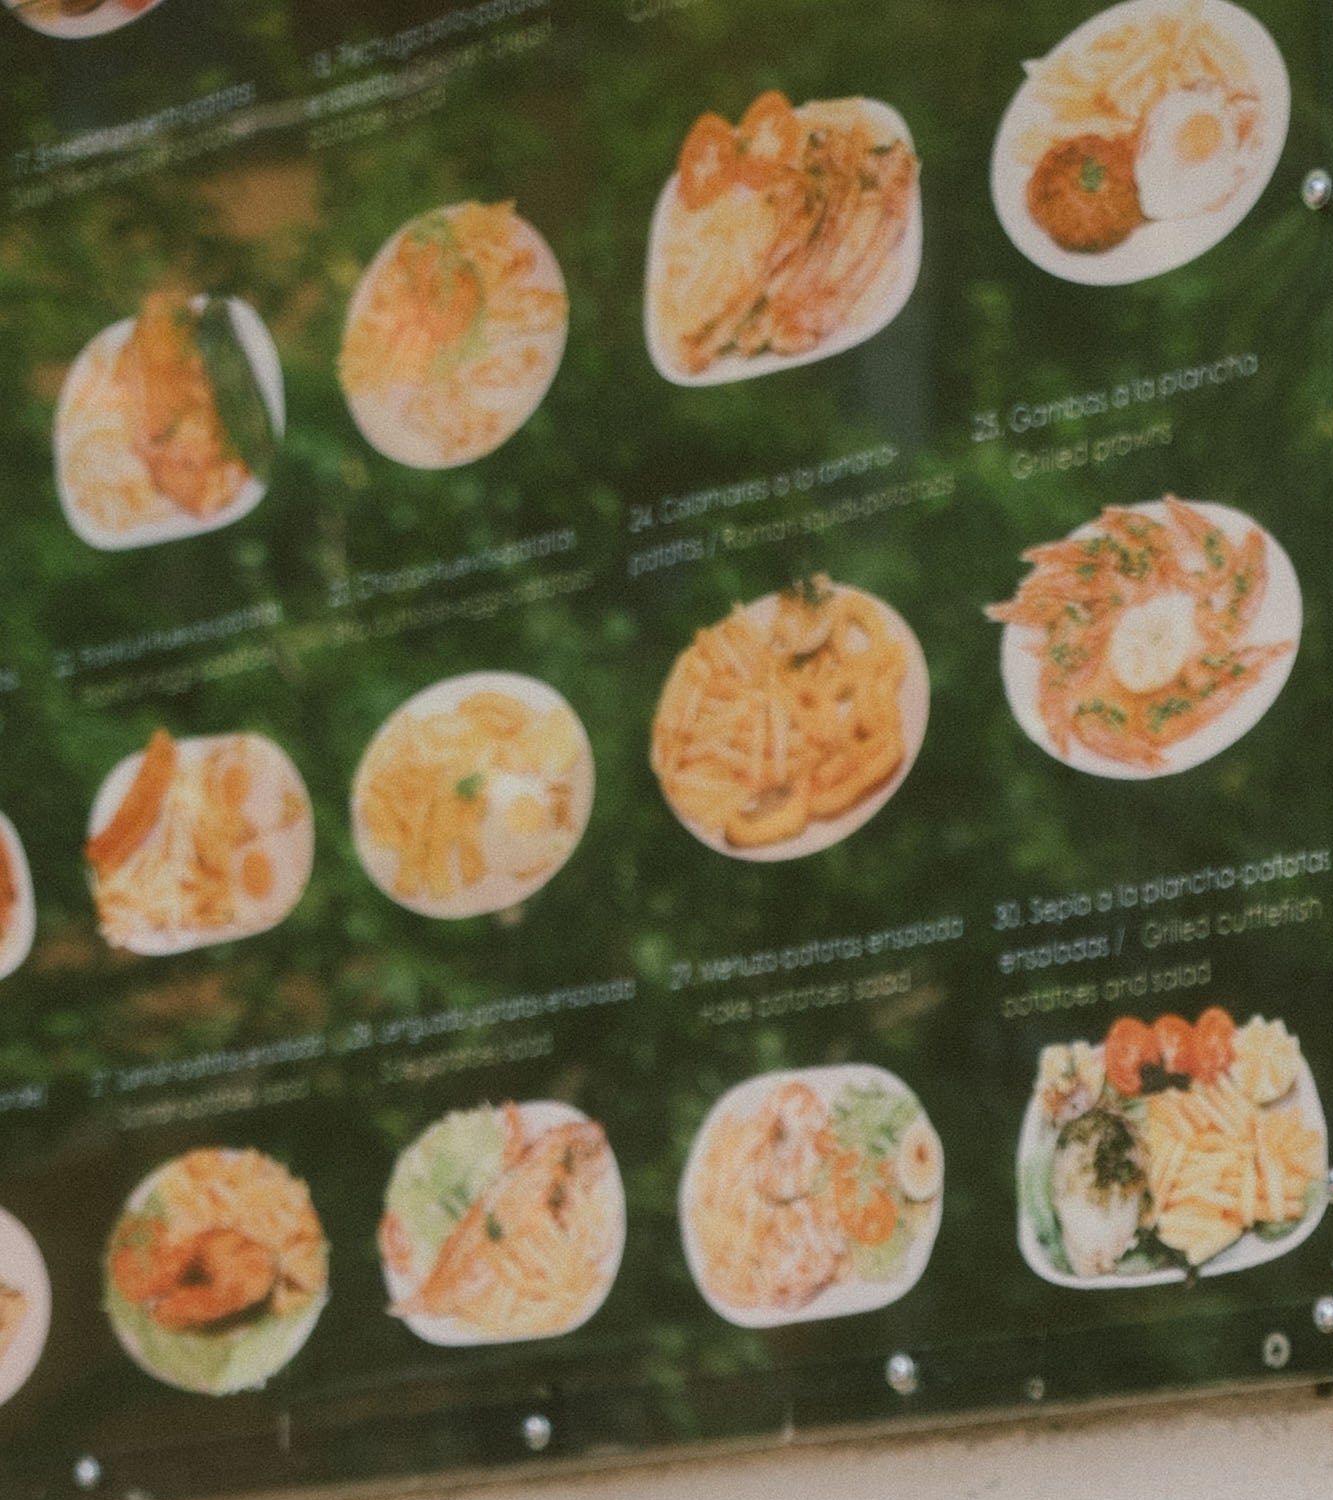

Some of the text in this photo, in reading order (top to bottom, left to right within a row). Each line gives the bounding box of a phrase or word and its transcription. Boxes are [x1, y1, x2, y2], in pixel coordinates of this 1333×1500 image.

[1010, 393, 1108, 432] Gambas
[1112, 386, 1130, 408] a
[1159, 353, 1259, 398] plancha
[1010, 423, 1172, 481] Grilled prawns
[657, 479, 771, 524] Calamares
[1029, 893, 1092, 925] Sepia
[1096, 891, 1113, 913] a
[1117, 881, 1139, 908] la
[998, 934, 1110, 975] ensaladas
[1140, 916, 1211, 950] Grilled
[1215, 895, 1324, 936] cuttlefish
[1002, 959, 1213, 1020] potatoes and salad
